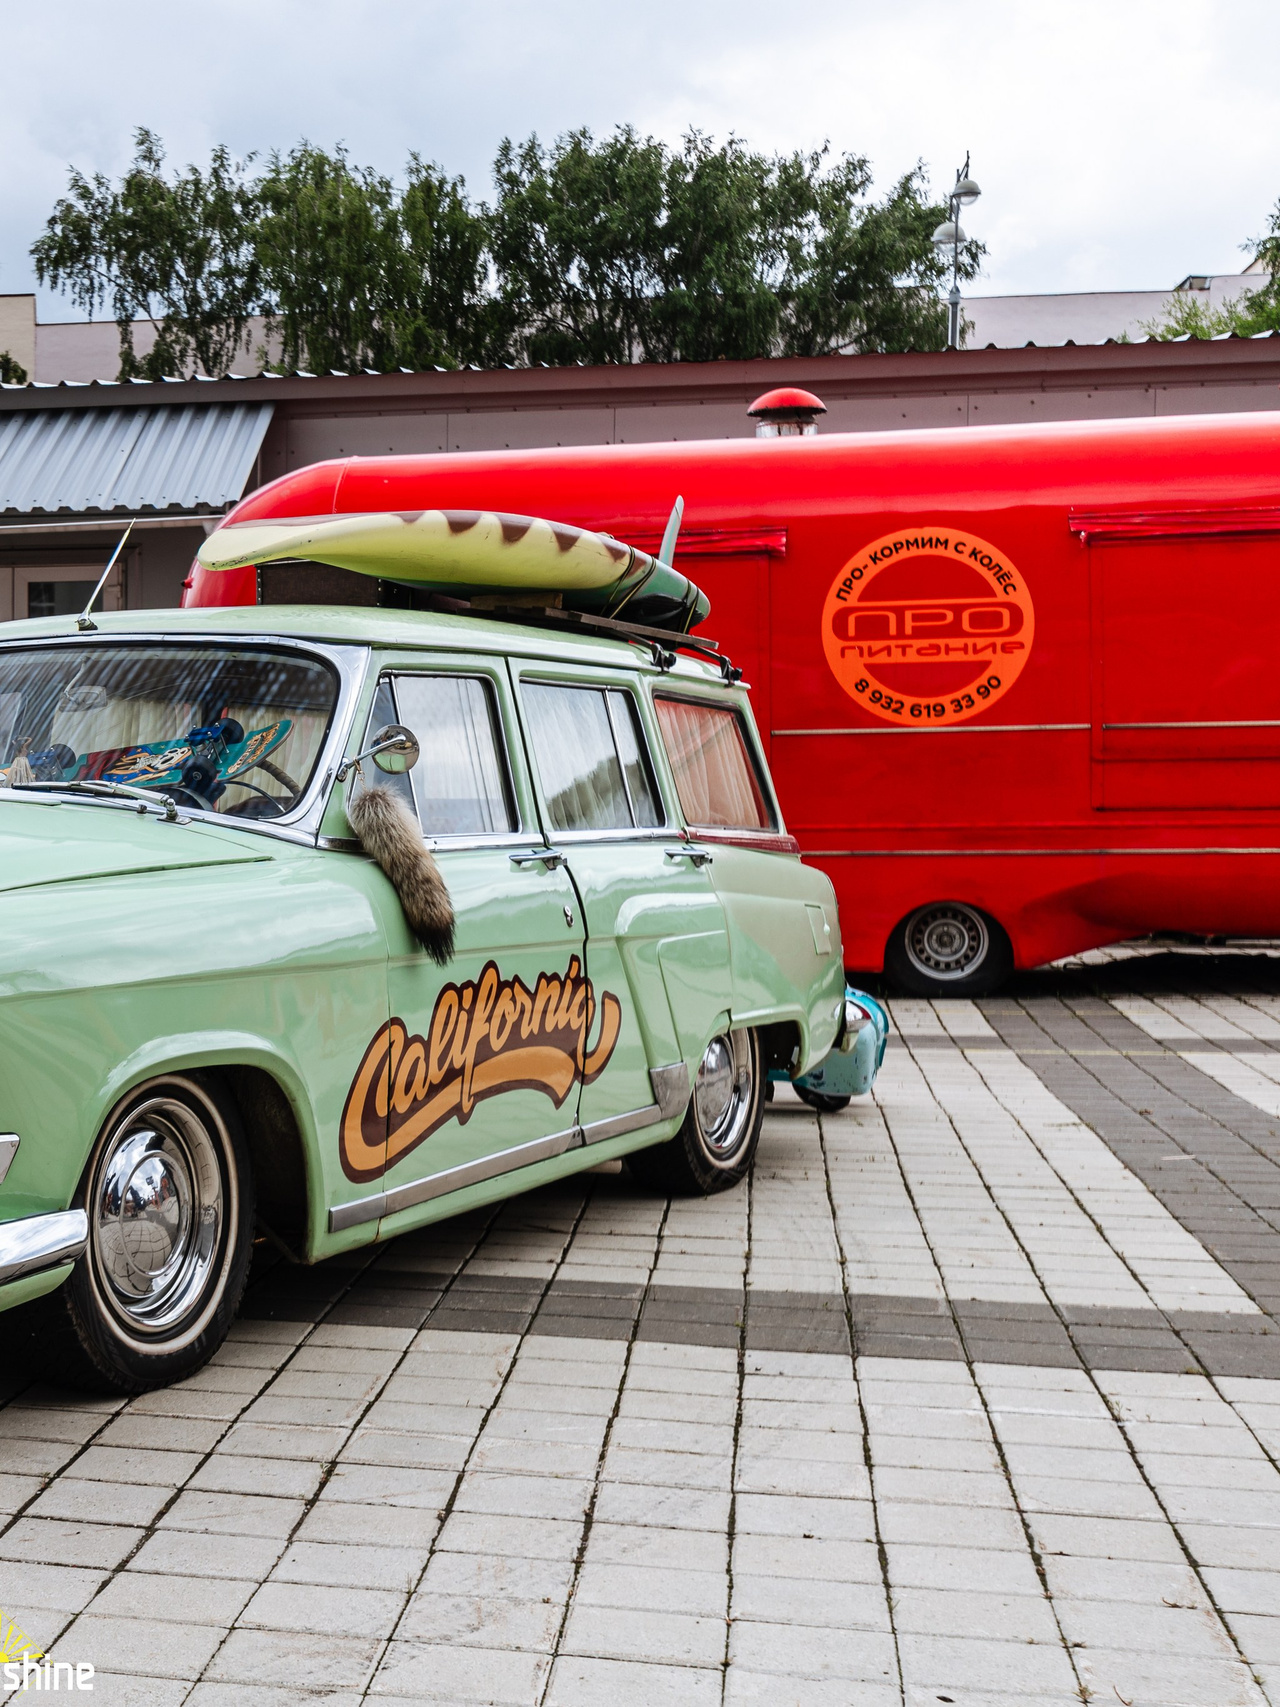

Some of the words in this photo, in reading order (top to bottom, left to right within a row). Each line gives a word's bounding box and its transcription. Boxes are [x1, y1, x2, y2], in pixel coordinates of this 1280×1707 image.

[835, 562, 870, 603] ПРО-
[868, 536, 950, 566] КОРМИМ
[953, 541, 968, 555] С
[968, 546, 1018, 597] КОЛЁС
[847, 606, 1011, 638] ПРО
[853, 678, 870, 695] 8
[868, 689, 905, 716] 932
[909, 703, 946, 719] 619
[949, 694, 976, 714] 33
[976, 674, 1003, 700] 90
[340, 955, 622, 1182] California
